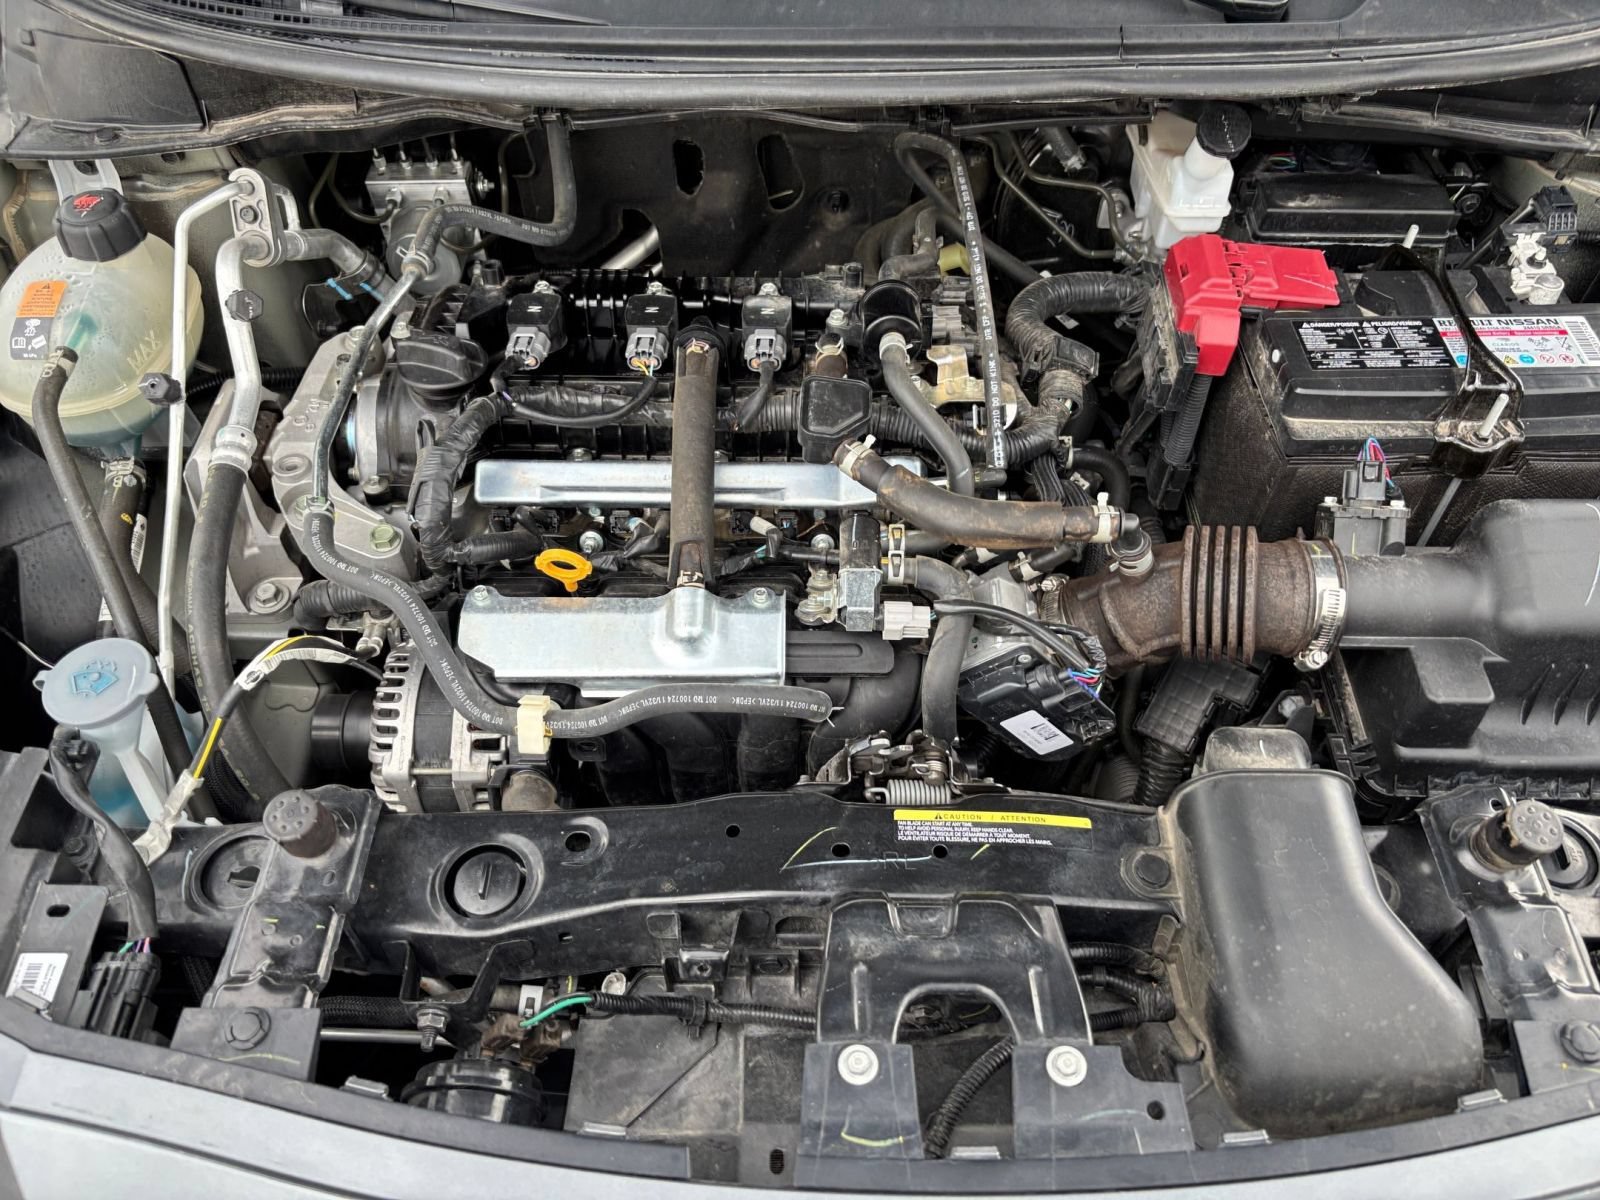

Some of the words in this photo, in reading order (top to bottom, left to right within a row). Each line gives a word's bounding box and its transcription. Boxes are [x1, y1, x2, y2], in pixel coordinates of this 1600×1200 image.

[127, 333, 161, 374] MAX
[988, 360, 997, 378] KINK
[990, 380, 998, 394] NOT
[992, 398, 1000, 407] DO
[409, 602, 427, 624] 100724
[705, 696, 717, 704] DOT
[786, 700, 809, 710] 100724
